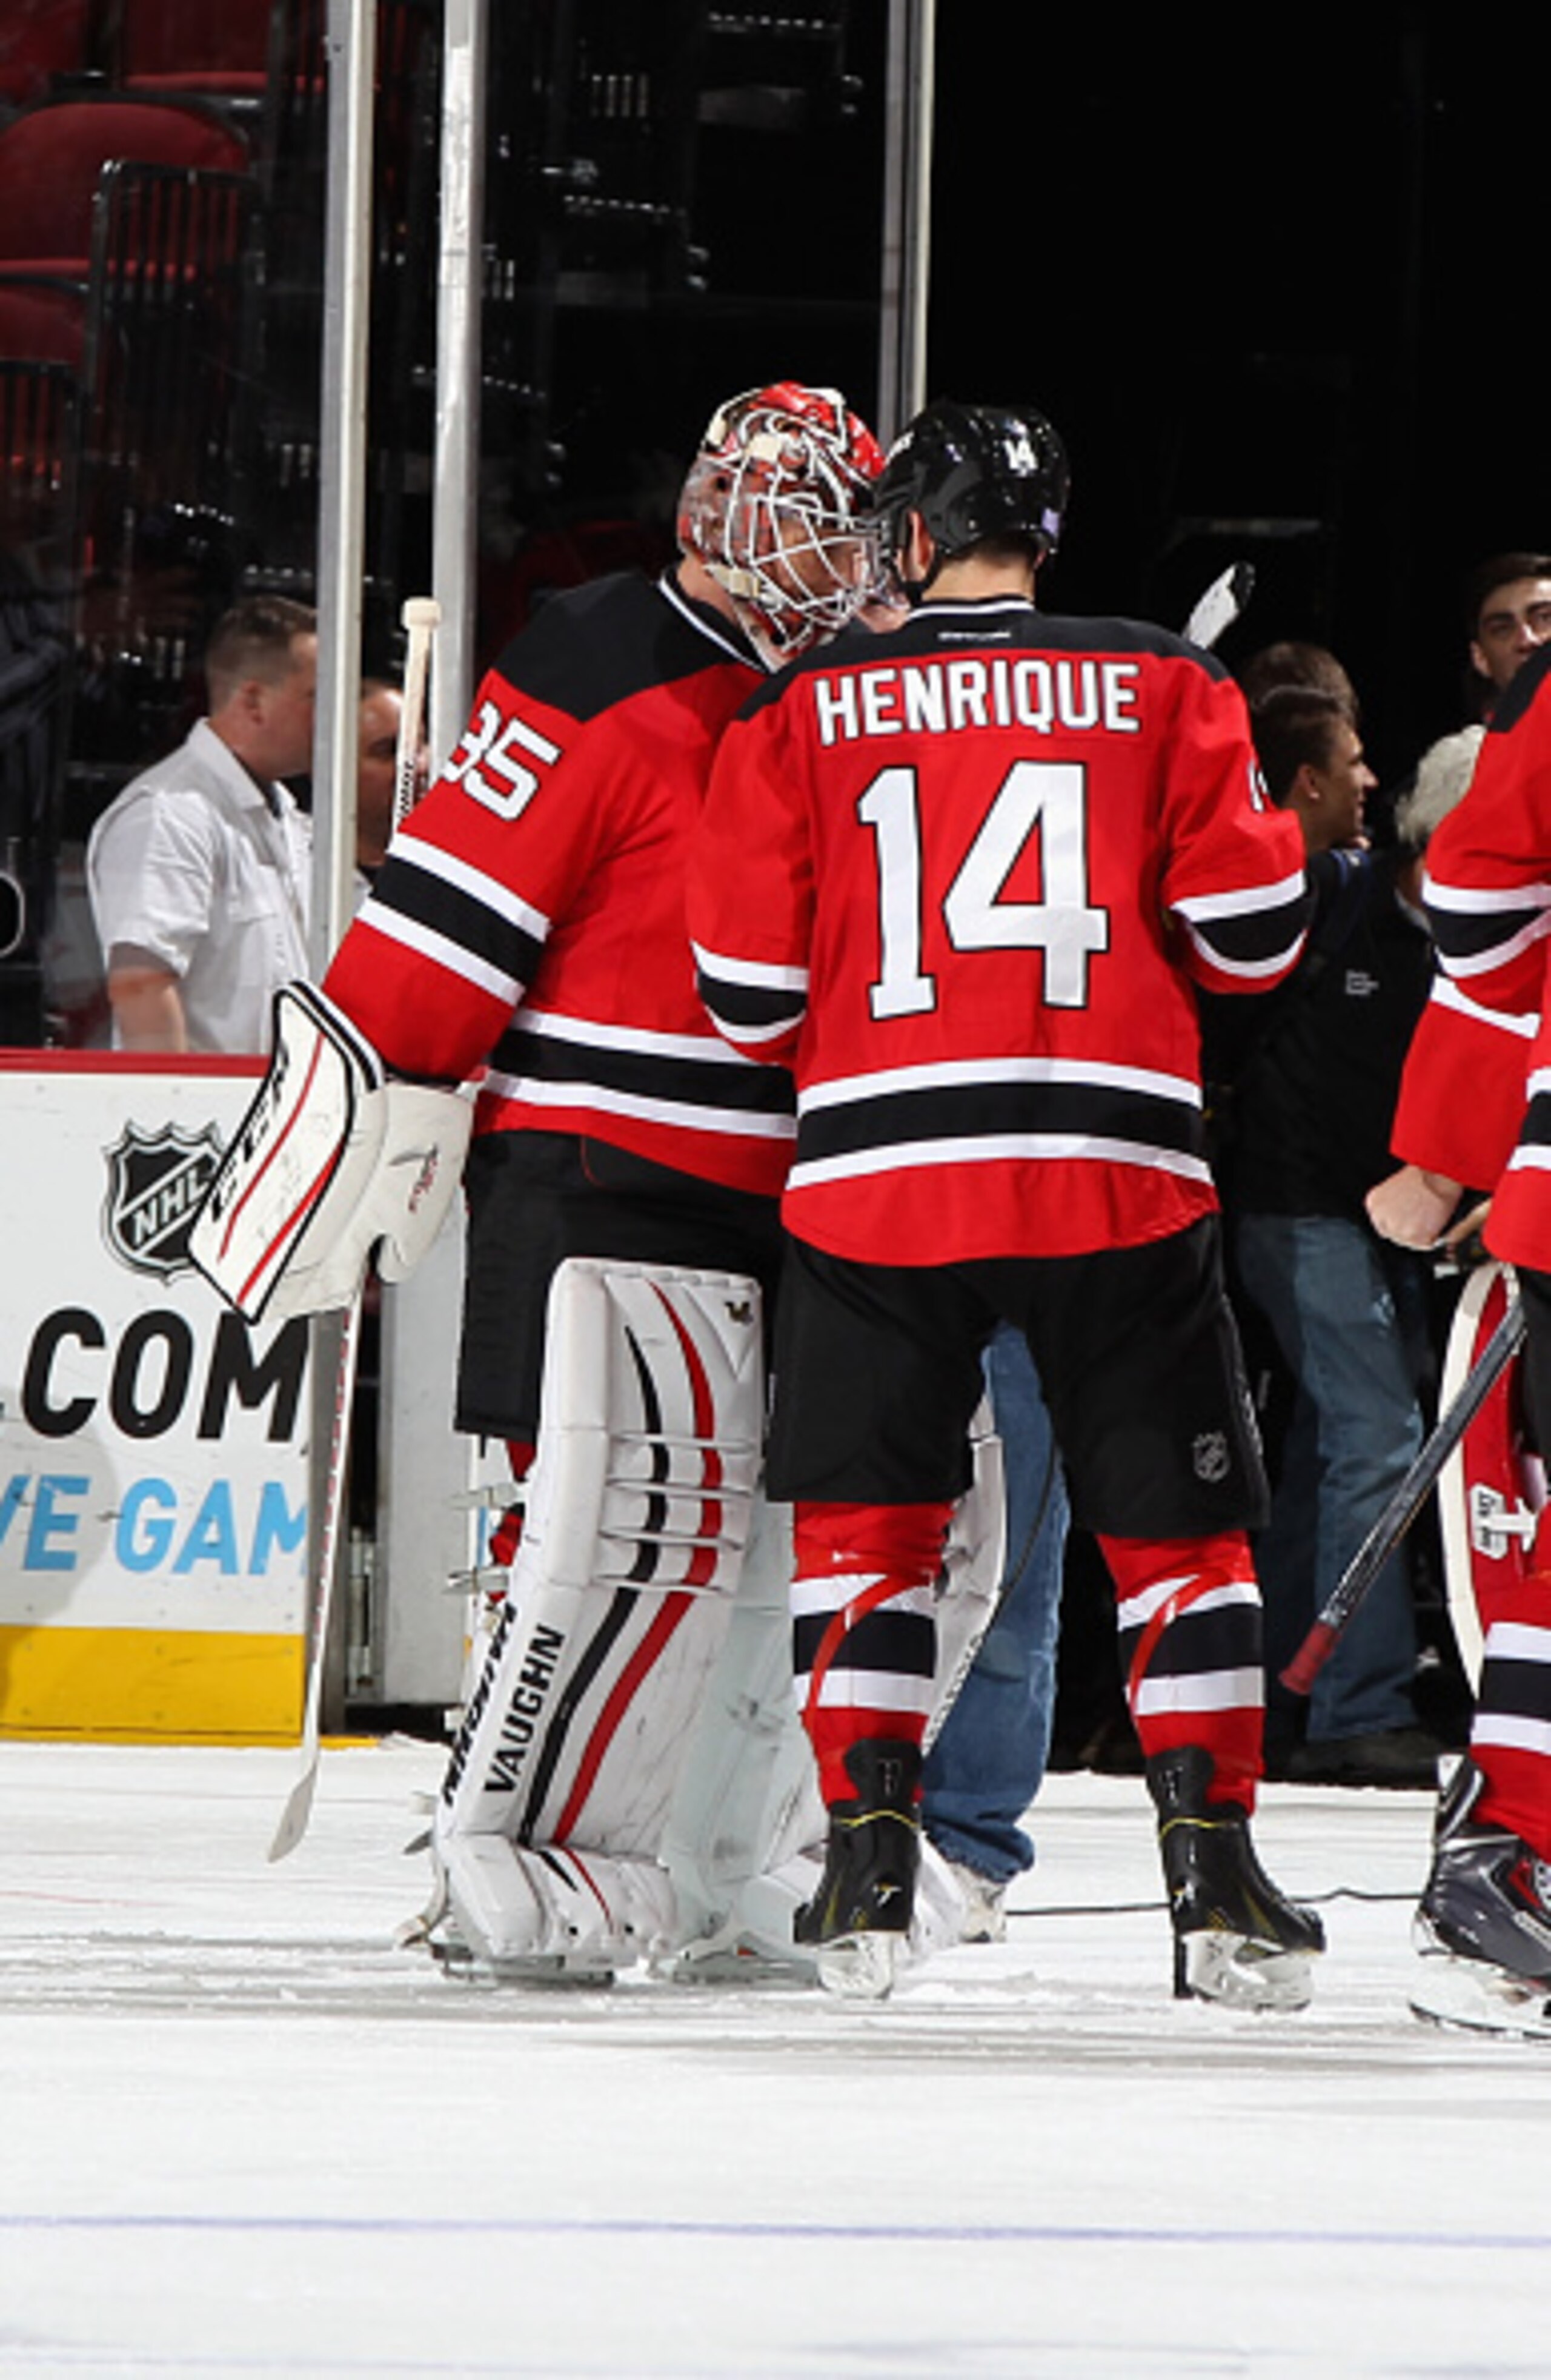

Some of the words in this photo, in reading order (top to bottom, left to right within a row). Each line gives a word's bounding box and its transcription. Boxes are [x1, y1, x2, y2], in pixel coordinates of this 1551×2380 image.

[1002, 437, 1038, 470] 14
[814, 658, 1140, 747] HENRIQUE
[856, 760, 1109, 1021] 14
[133, 1166, 210, 1245] NHL
[485, 1623, 566, 1792] VAUGHN
